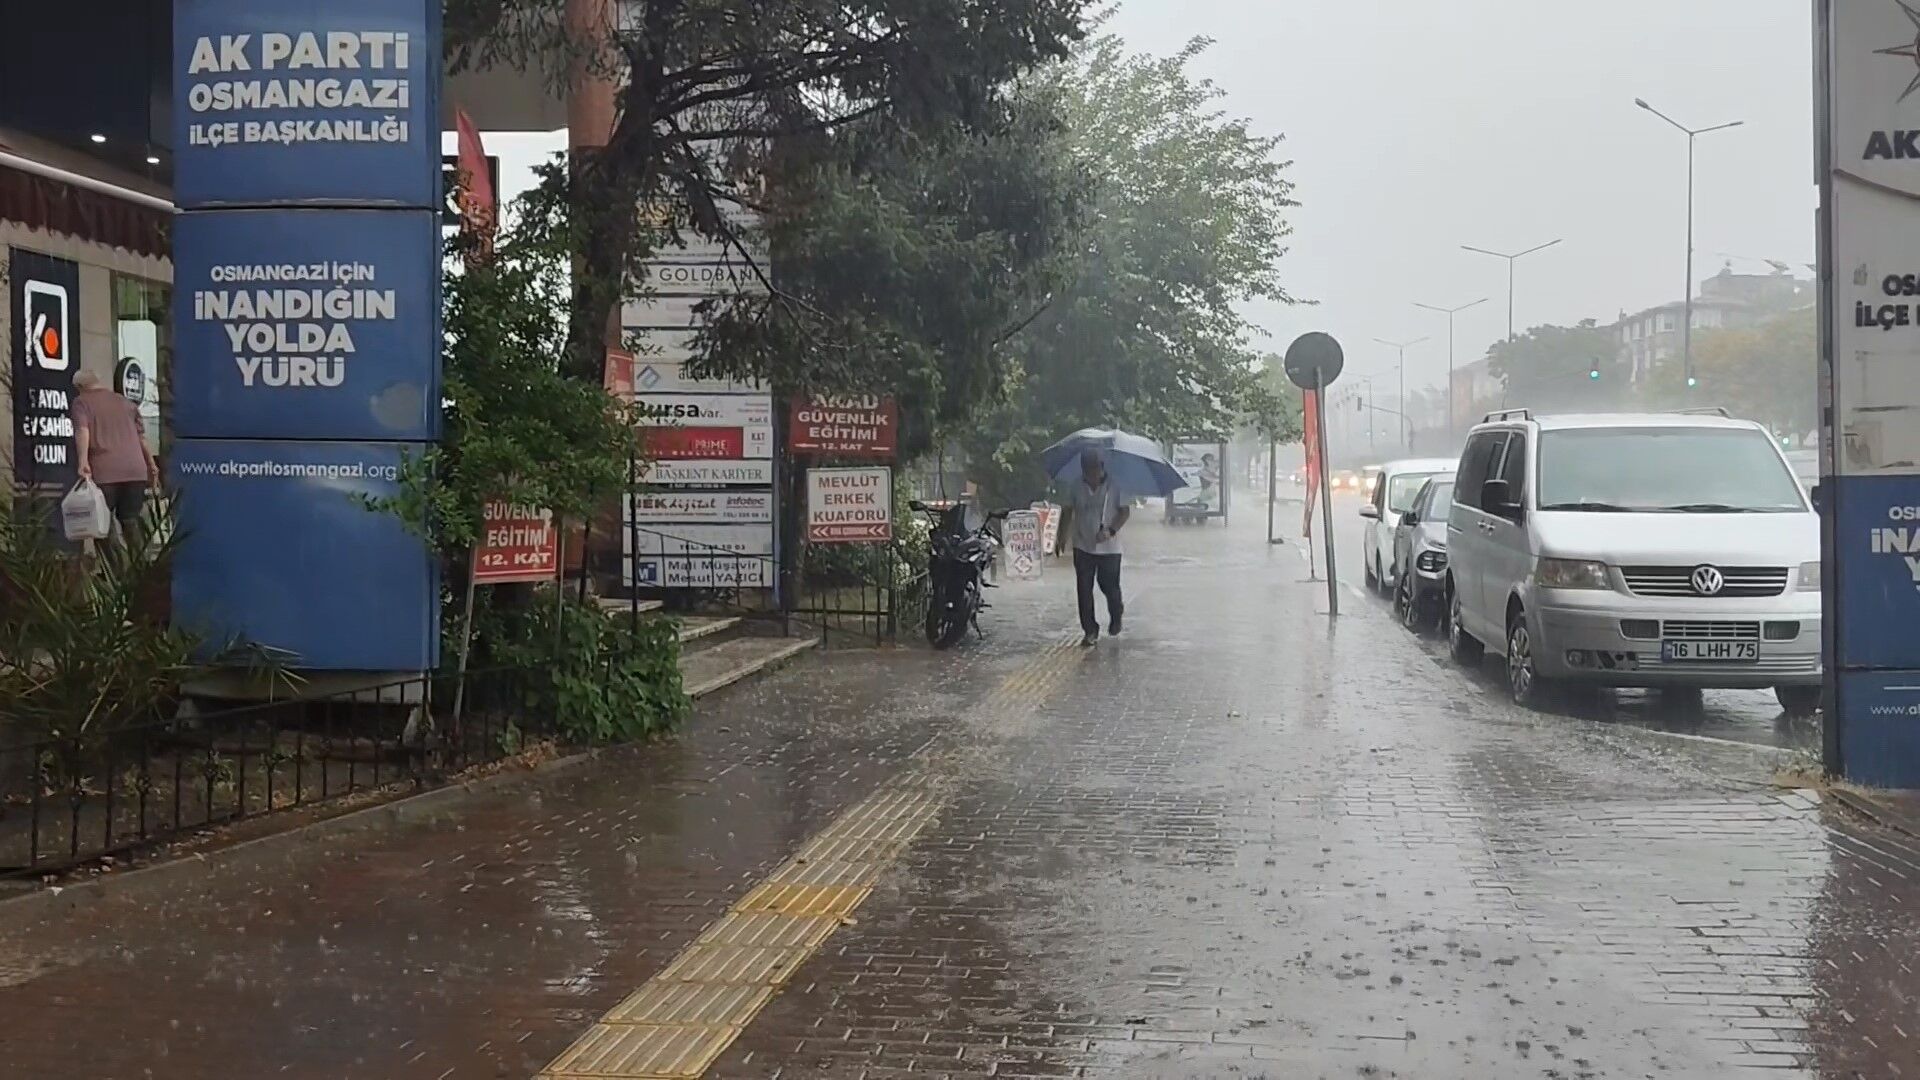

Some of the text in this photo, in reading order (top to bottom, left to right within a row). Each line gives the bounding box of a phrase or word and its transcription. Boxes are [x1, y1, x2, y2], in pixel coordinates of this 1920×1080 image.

[188, 31, 409, 74] AK PARTİ
[188, 78, 409, 112] OSMANGAZİ
[189, 115, 409, 148] İLÇE BAŞKANLIĞI
[210, 261, 375, 284] OSMANGAZİ İÇİN
[1882, 273, 1920, 297] OS
[194, 285, 396, 320] İNANDIĞIN
[1856, 301, 1909, 332] İLÇE
[224, 322, 356, 353] YOLDA
[235, 356, 345, 387] YÜRÜ
[38, 388, 69, 410] AYDA
[797, 409, 889, 426] GÜVENLİK
[809, 425, 878, 441] EĞİTİMİ
[34, 444, 67, 465] OLUN
[180, 459, 398, 482] www.akpartiosmangazi.org
[824, 493, 876, 505] ERKEK
[487, 525, 548, 548] EĞİTİMİ
[481, 552, 552, 567] 12. KAT
[1672, 643, 1755, 657] 16 LHH 75
